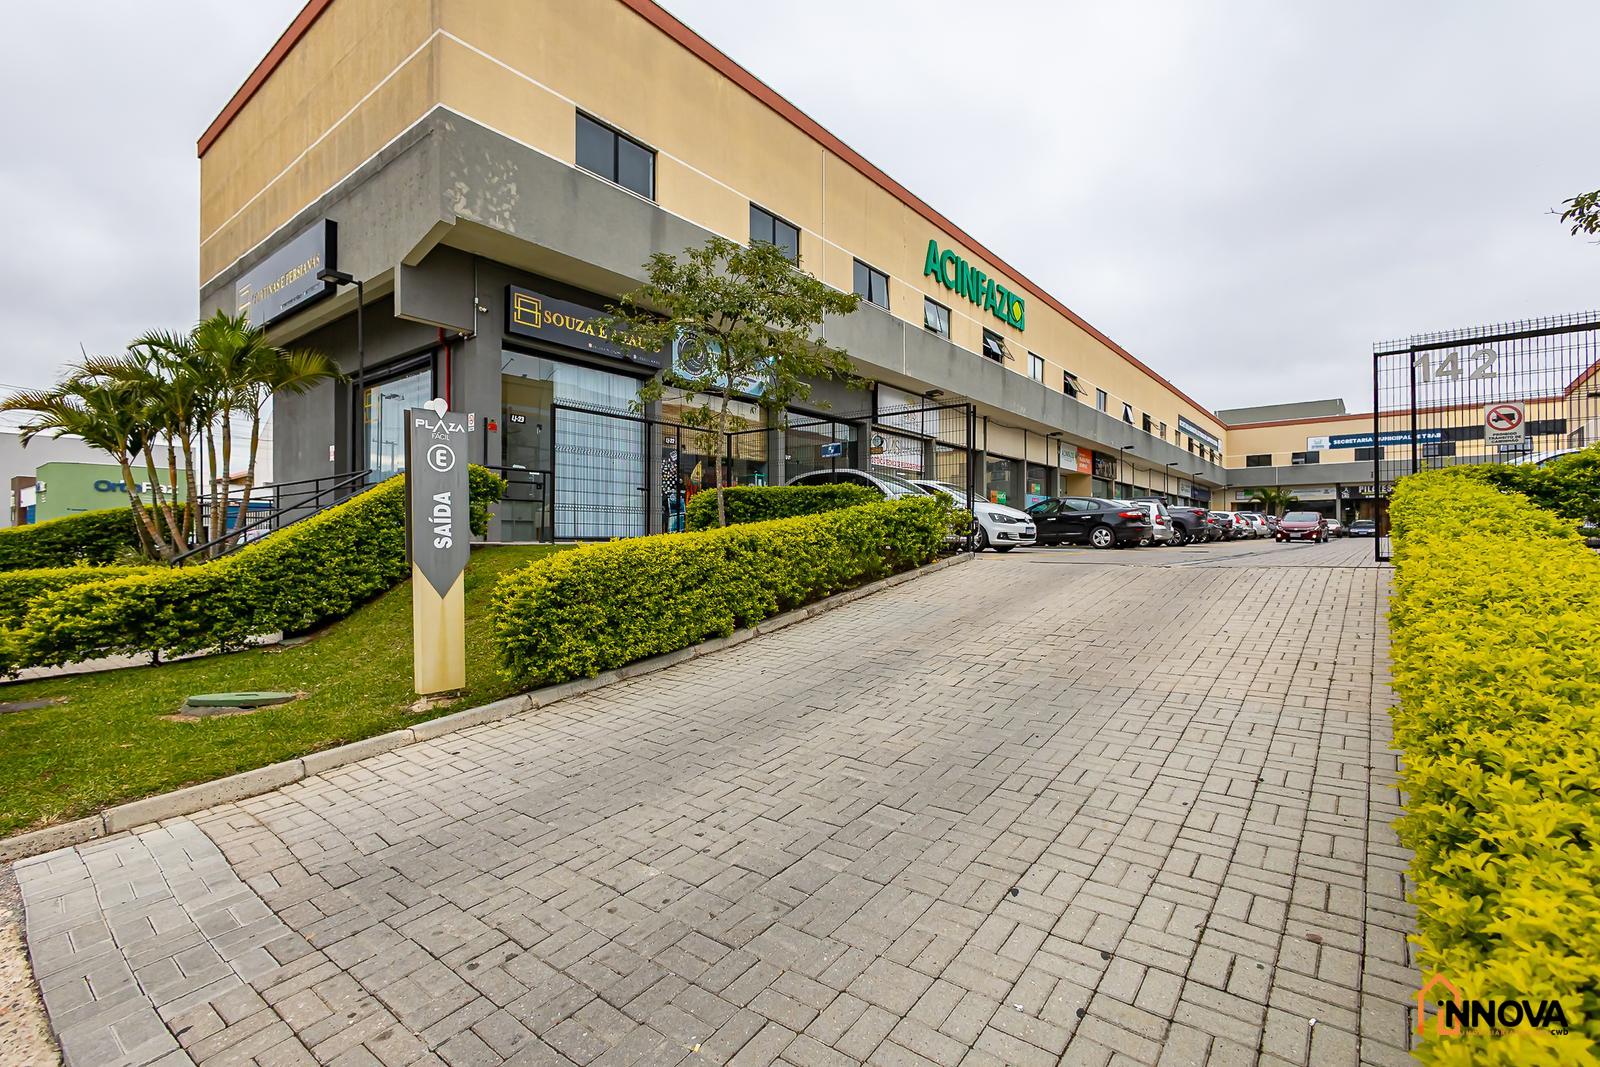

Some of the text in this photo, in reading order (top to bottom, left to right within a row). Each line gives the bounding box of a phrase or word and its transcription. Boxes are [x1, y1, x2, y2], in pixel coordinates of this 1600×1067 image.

[543, 310, 595, 337] SOUZA
[1413, 348, 1497, 383] 142
[415, 418, 465, 434] PLAZA
[431, 431, 450, 441] FÁCIL
[1333, 437, 1373, 445] SECRETARIA
[1378, 433, 1412, 441] UNICIPAL
[435, 449, 447, 467] E
[428, 491, 453, 549] SAÍDA
